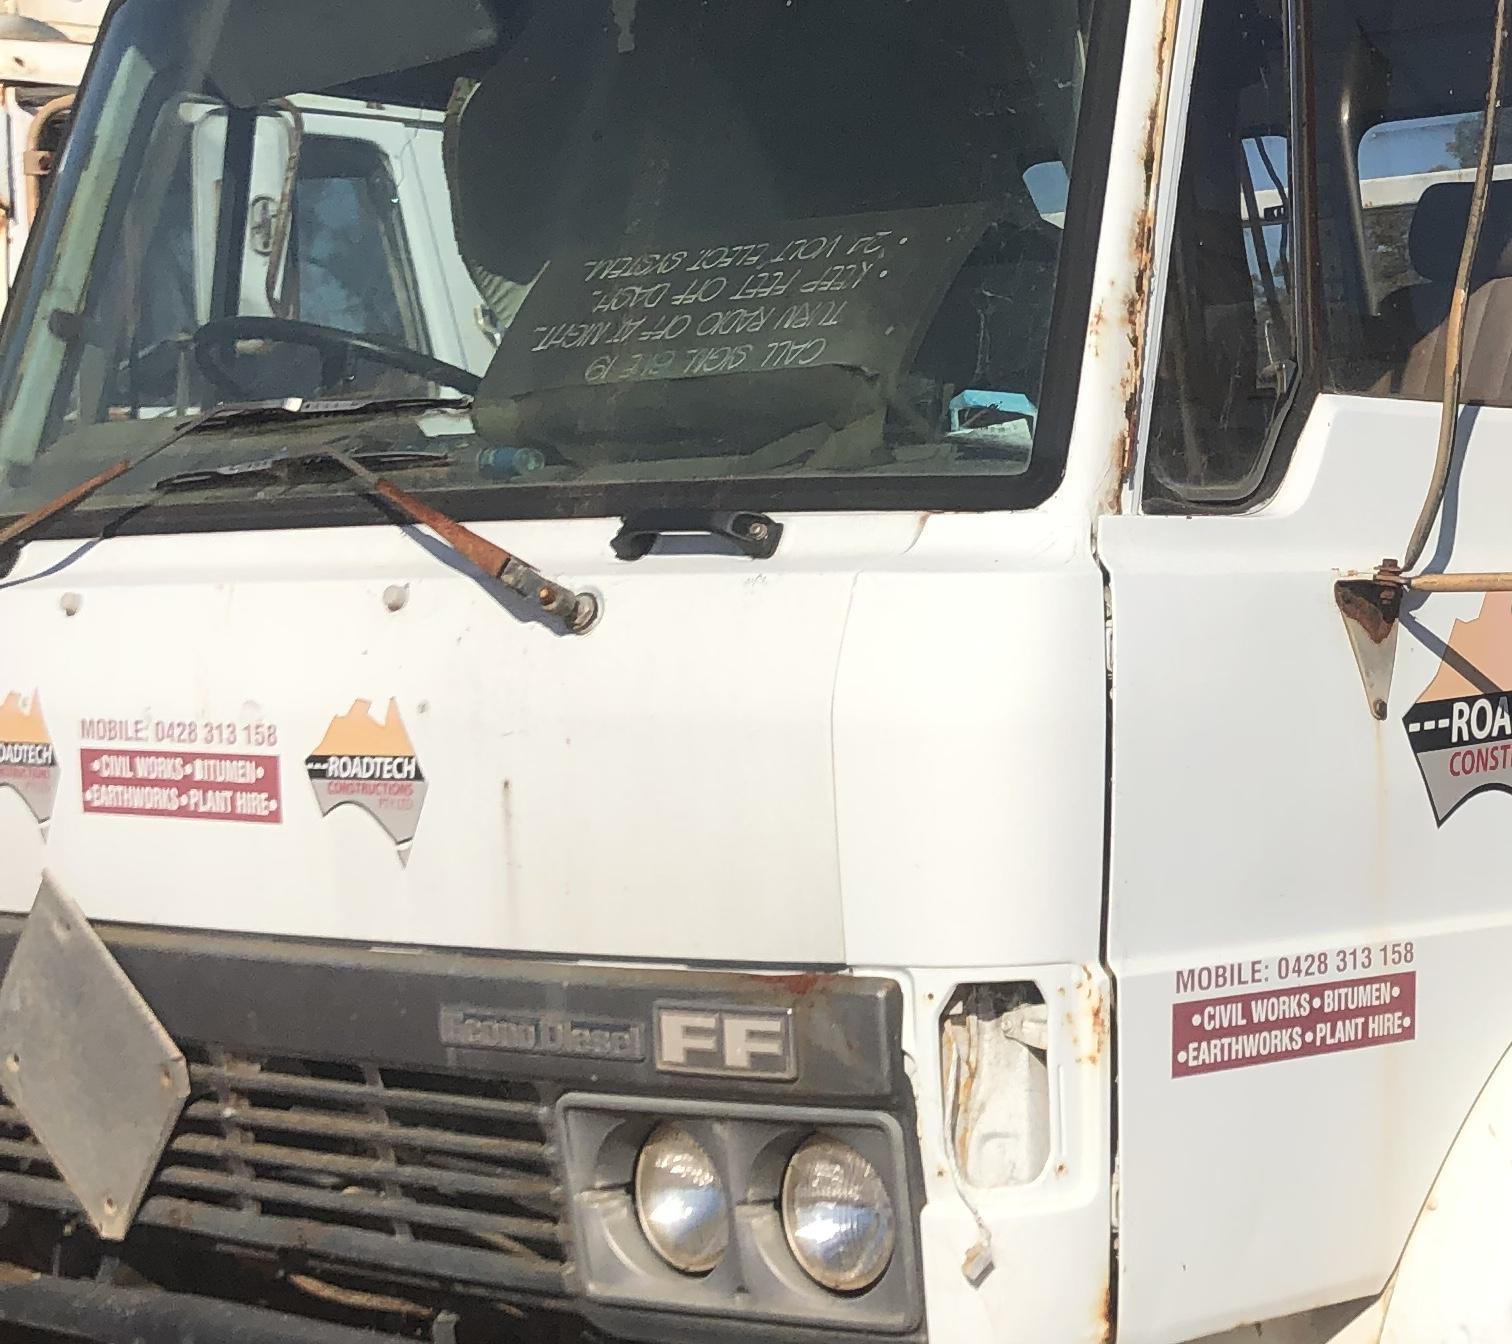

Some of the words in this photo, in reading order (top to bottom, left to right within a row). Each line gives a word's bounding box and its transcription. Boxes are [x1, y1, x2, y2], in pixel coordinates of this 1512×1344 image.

[770, 234, 843, 263] VOLT
[729, 268, 802, 300] FEET
[800, 260, 874, 293] KEEP
[671, 277, 727, 306] OFF
[605, 315, 648, 344] AT
[638, 314, 692, 341] OFF
[696, 306, 776, 337] RADIO
[773, 300, 848, 330] TURN
[760, 338, 827, 368] CALL
[584, 355, 618, 382] 19
[155, 720, 198, 744] 0428
[204, 722, 237, 745] 313
[243, 723, 278, 747] 158
[99, 754, 134, 778] CIVIL
[135, 756, 184, 781] WORKS
[327, 755, 416, 779] ROADTECH
[188, 788, 233, 813] PLANT
[235, 791, 270, 816] HIRE
[1175, 960, 1269, 994] MOBILE:
[1277, 952, 1328, 980] 0428
[1336, 946, 1373, 973] 313
[1379, 941, 1415, 966] 158
[1203, 1003, 1247, 1031] CIVIL
[1250, 993, 1311, 1024] WORKS
[1323, 981, 1392, 1013] BITUMEN
[658, 1009, 784, 1069] FF
[1188, 1027, 1303, 1067] EARTHWORKS
[1316, 1019, 1365, 1046] PLANT
[1368, 1012, 1403, 1038] HIRE
